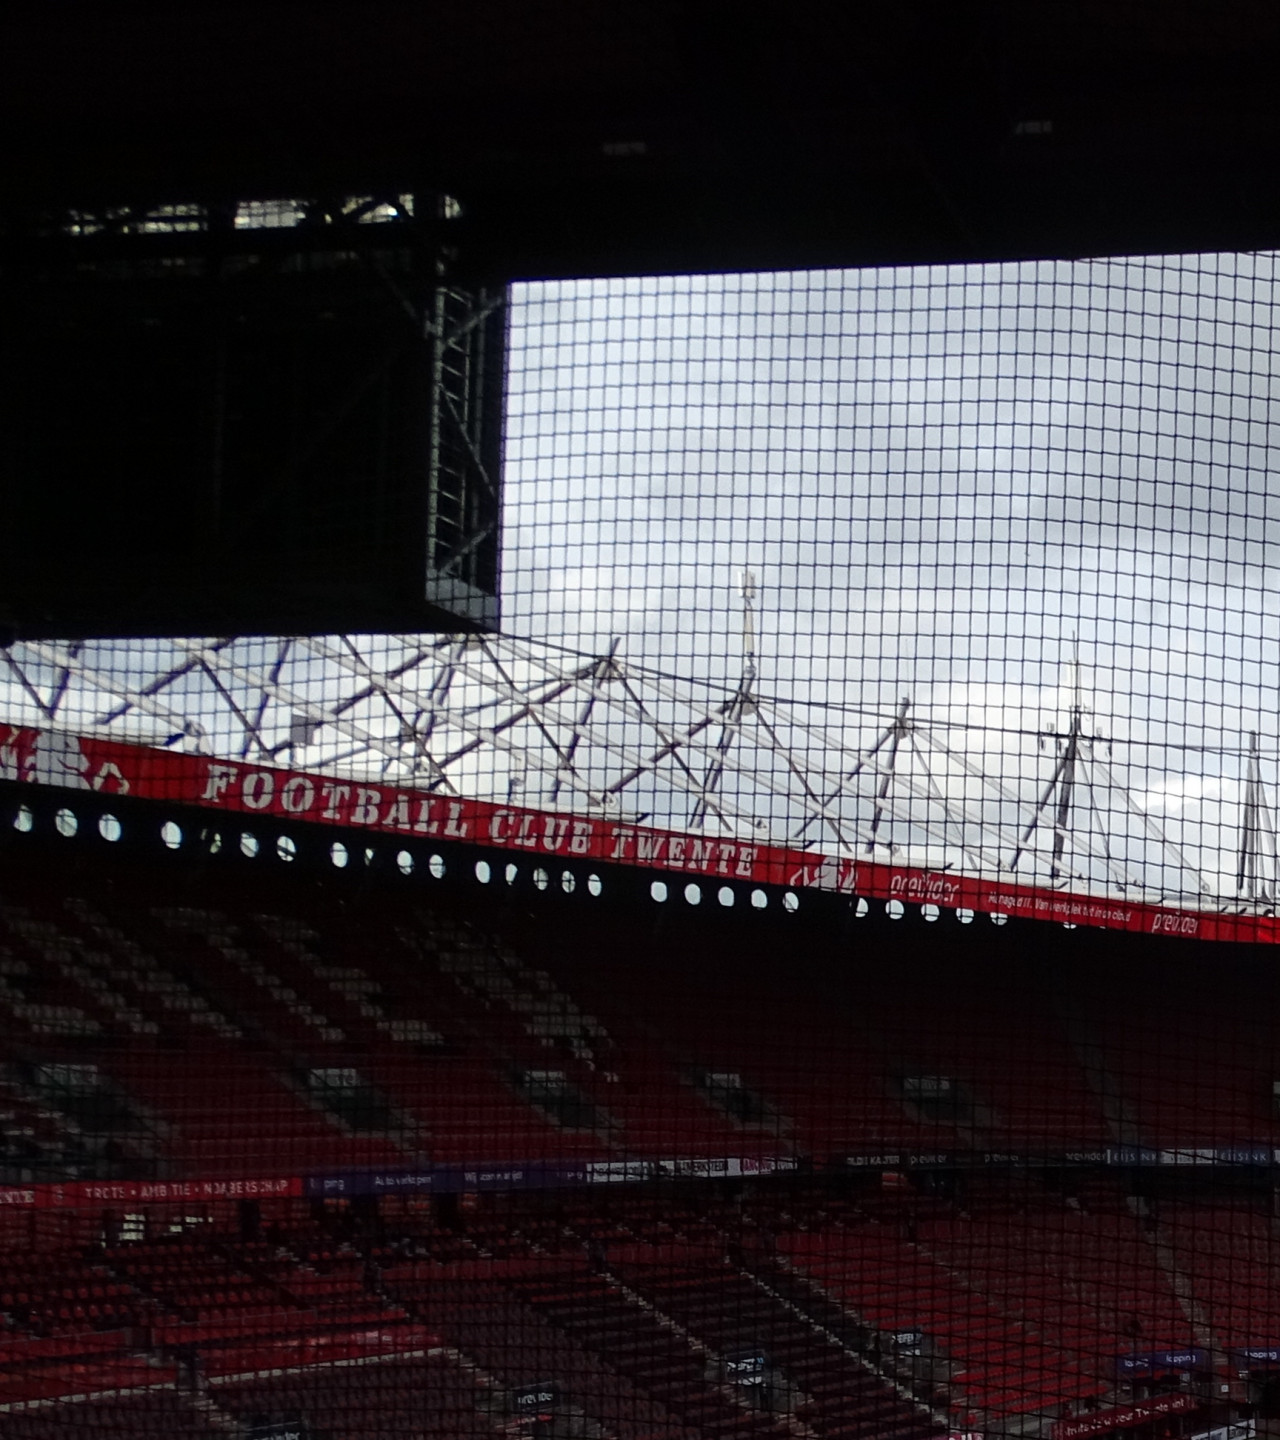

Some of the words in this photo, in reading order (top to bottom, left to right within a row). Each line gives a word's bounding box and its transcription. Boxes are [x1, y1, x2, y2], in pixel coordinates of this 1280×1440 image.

[201, 764, 468, 838] FOOTBALL
[488, 809, 594, 854] CLUB
[610, 827, 758, 876] TWENTE
[141, 1182, 191, 1198] AMBTIE
